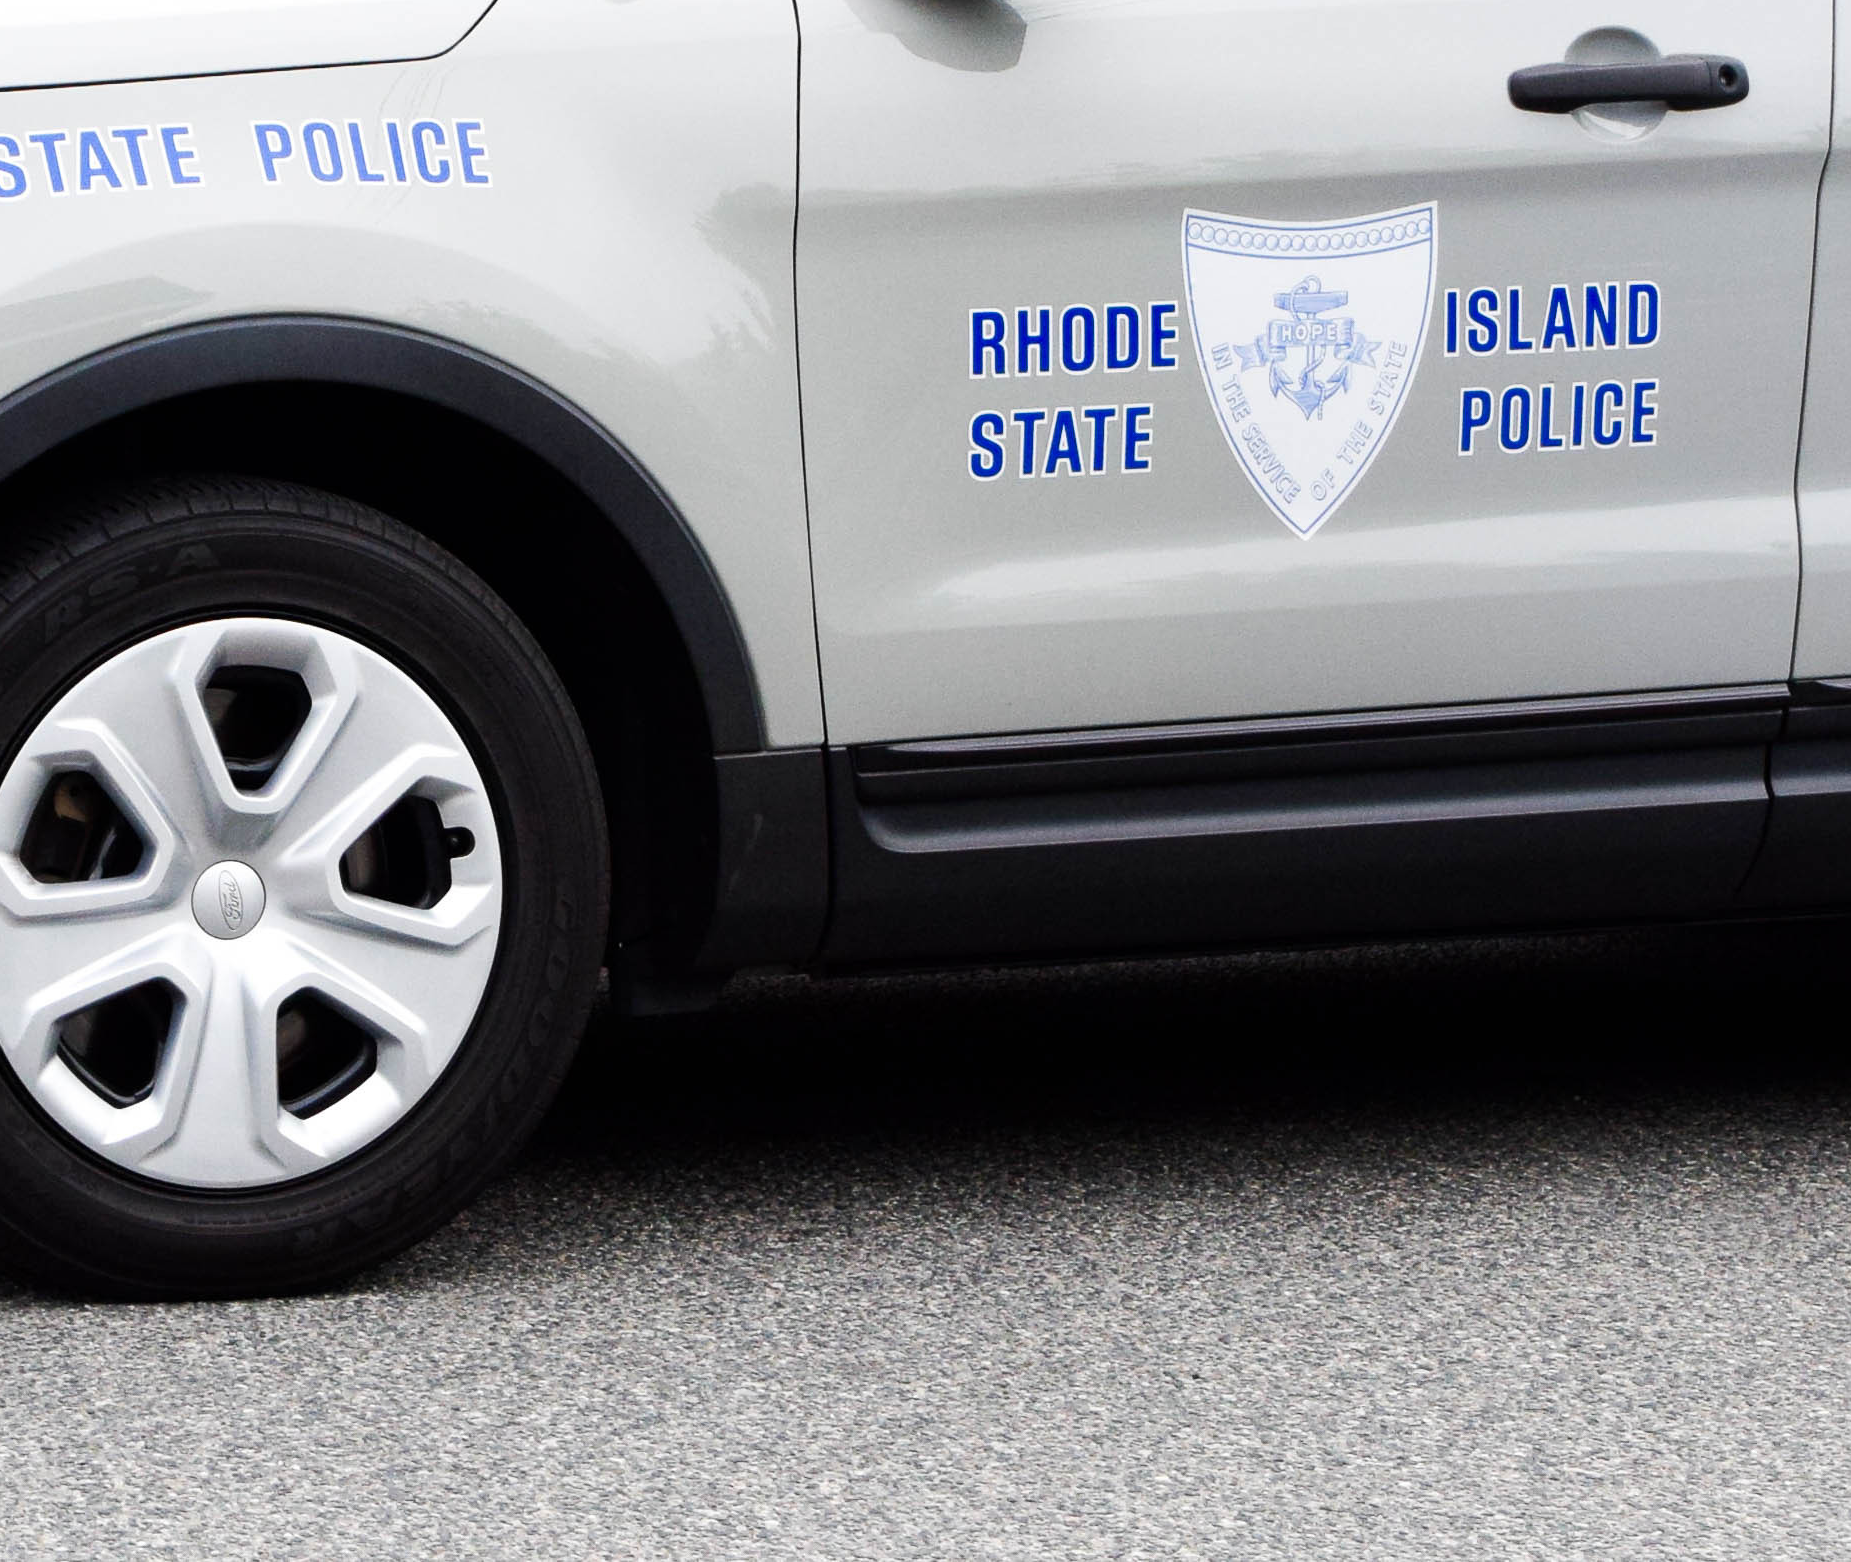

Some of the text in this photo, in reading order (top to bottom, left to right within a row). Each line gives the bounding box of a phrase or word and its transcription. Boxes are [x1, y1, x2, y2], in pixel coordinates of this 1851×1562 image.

[252, 118, 491, 185] POLICE
[970, 280, 1662, 377] RHODE ISLAND
[1280, 322, 1339, 343] HOPE
[967, 379, 1659, 480] STATE POLICE
[1210, 340, 1409, 505] IN THE SERVICE OF THE STATE
